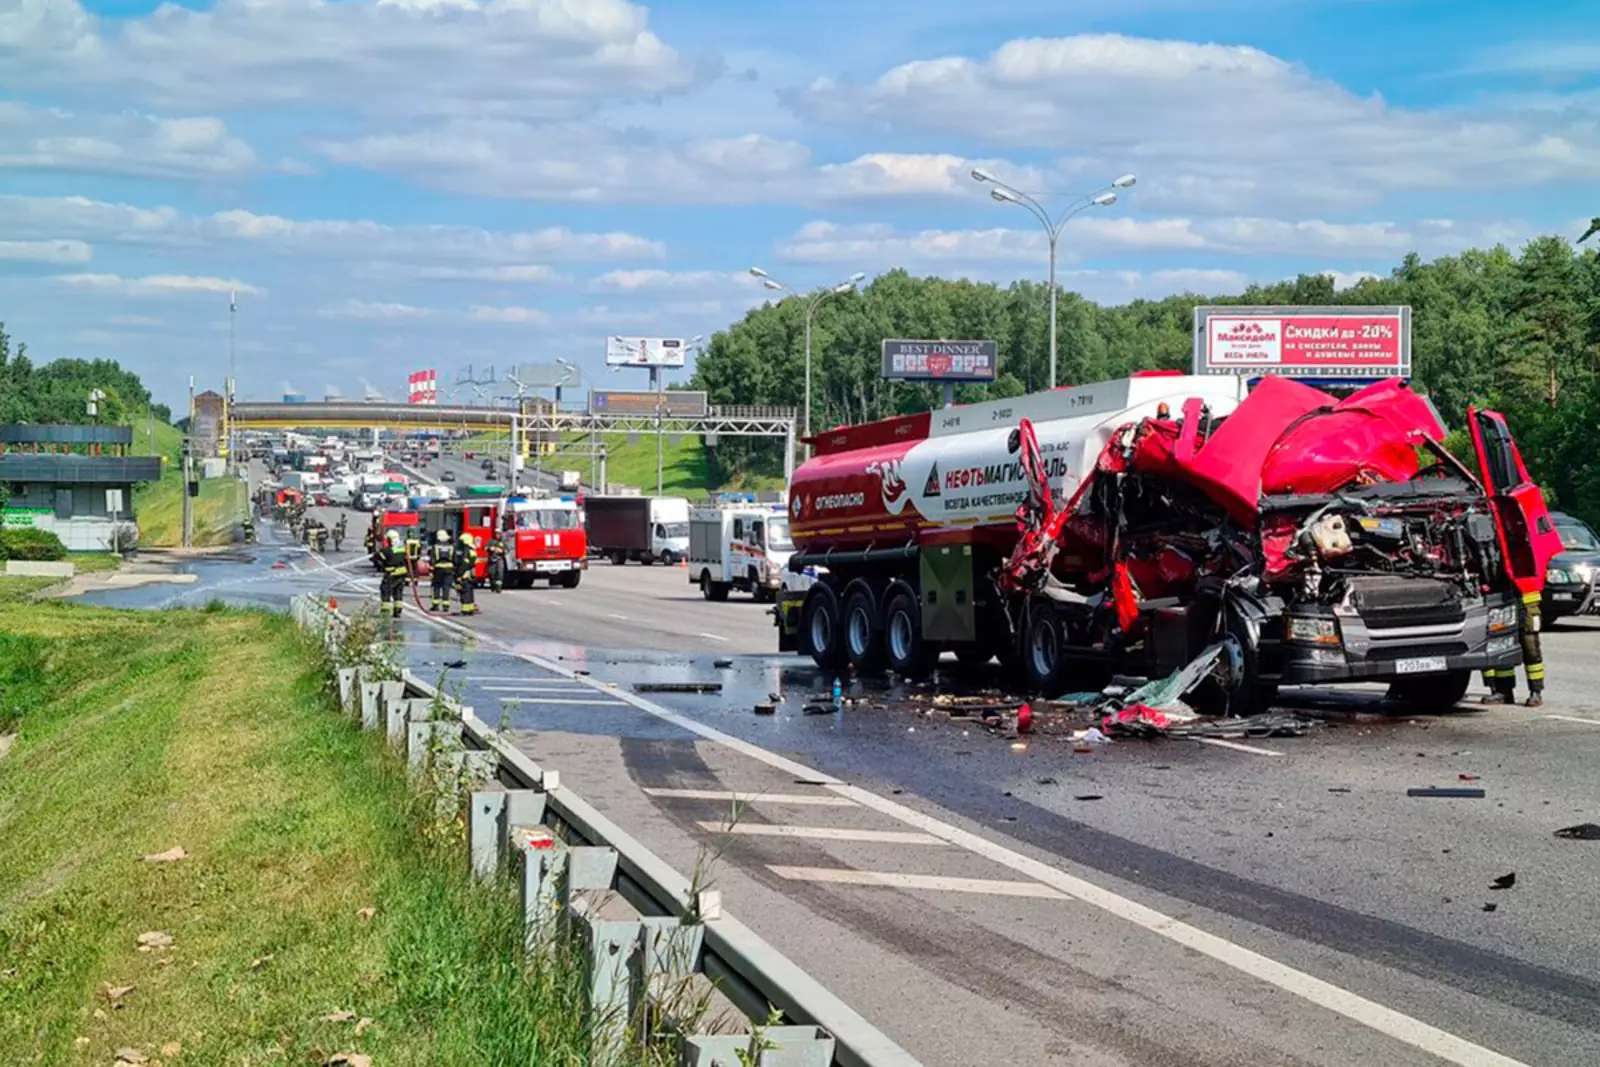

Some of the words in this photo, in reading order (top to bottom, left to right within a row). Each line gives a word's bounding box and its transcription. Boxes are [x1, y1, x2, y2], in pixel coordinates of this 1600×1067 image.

[1341, 329, 1355, 339] до
[1357, 325, 1392, 338] -20%
[900, 344, 930, 353] BEST
[933, 344, 981, 353] DINNER
[815, 492, 864, 510] ОГНЕОПАСНО
[944, 497, 969, 510] ВСЕГДА
[971, 490, 1023, 507] КАЧЕСТВЕННОЕ
